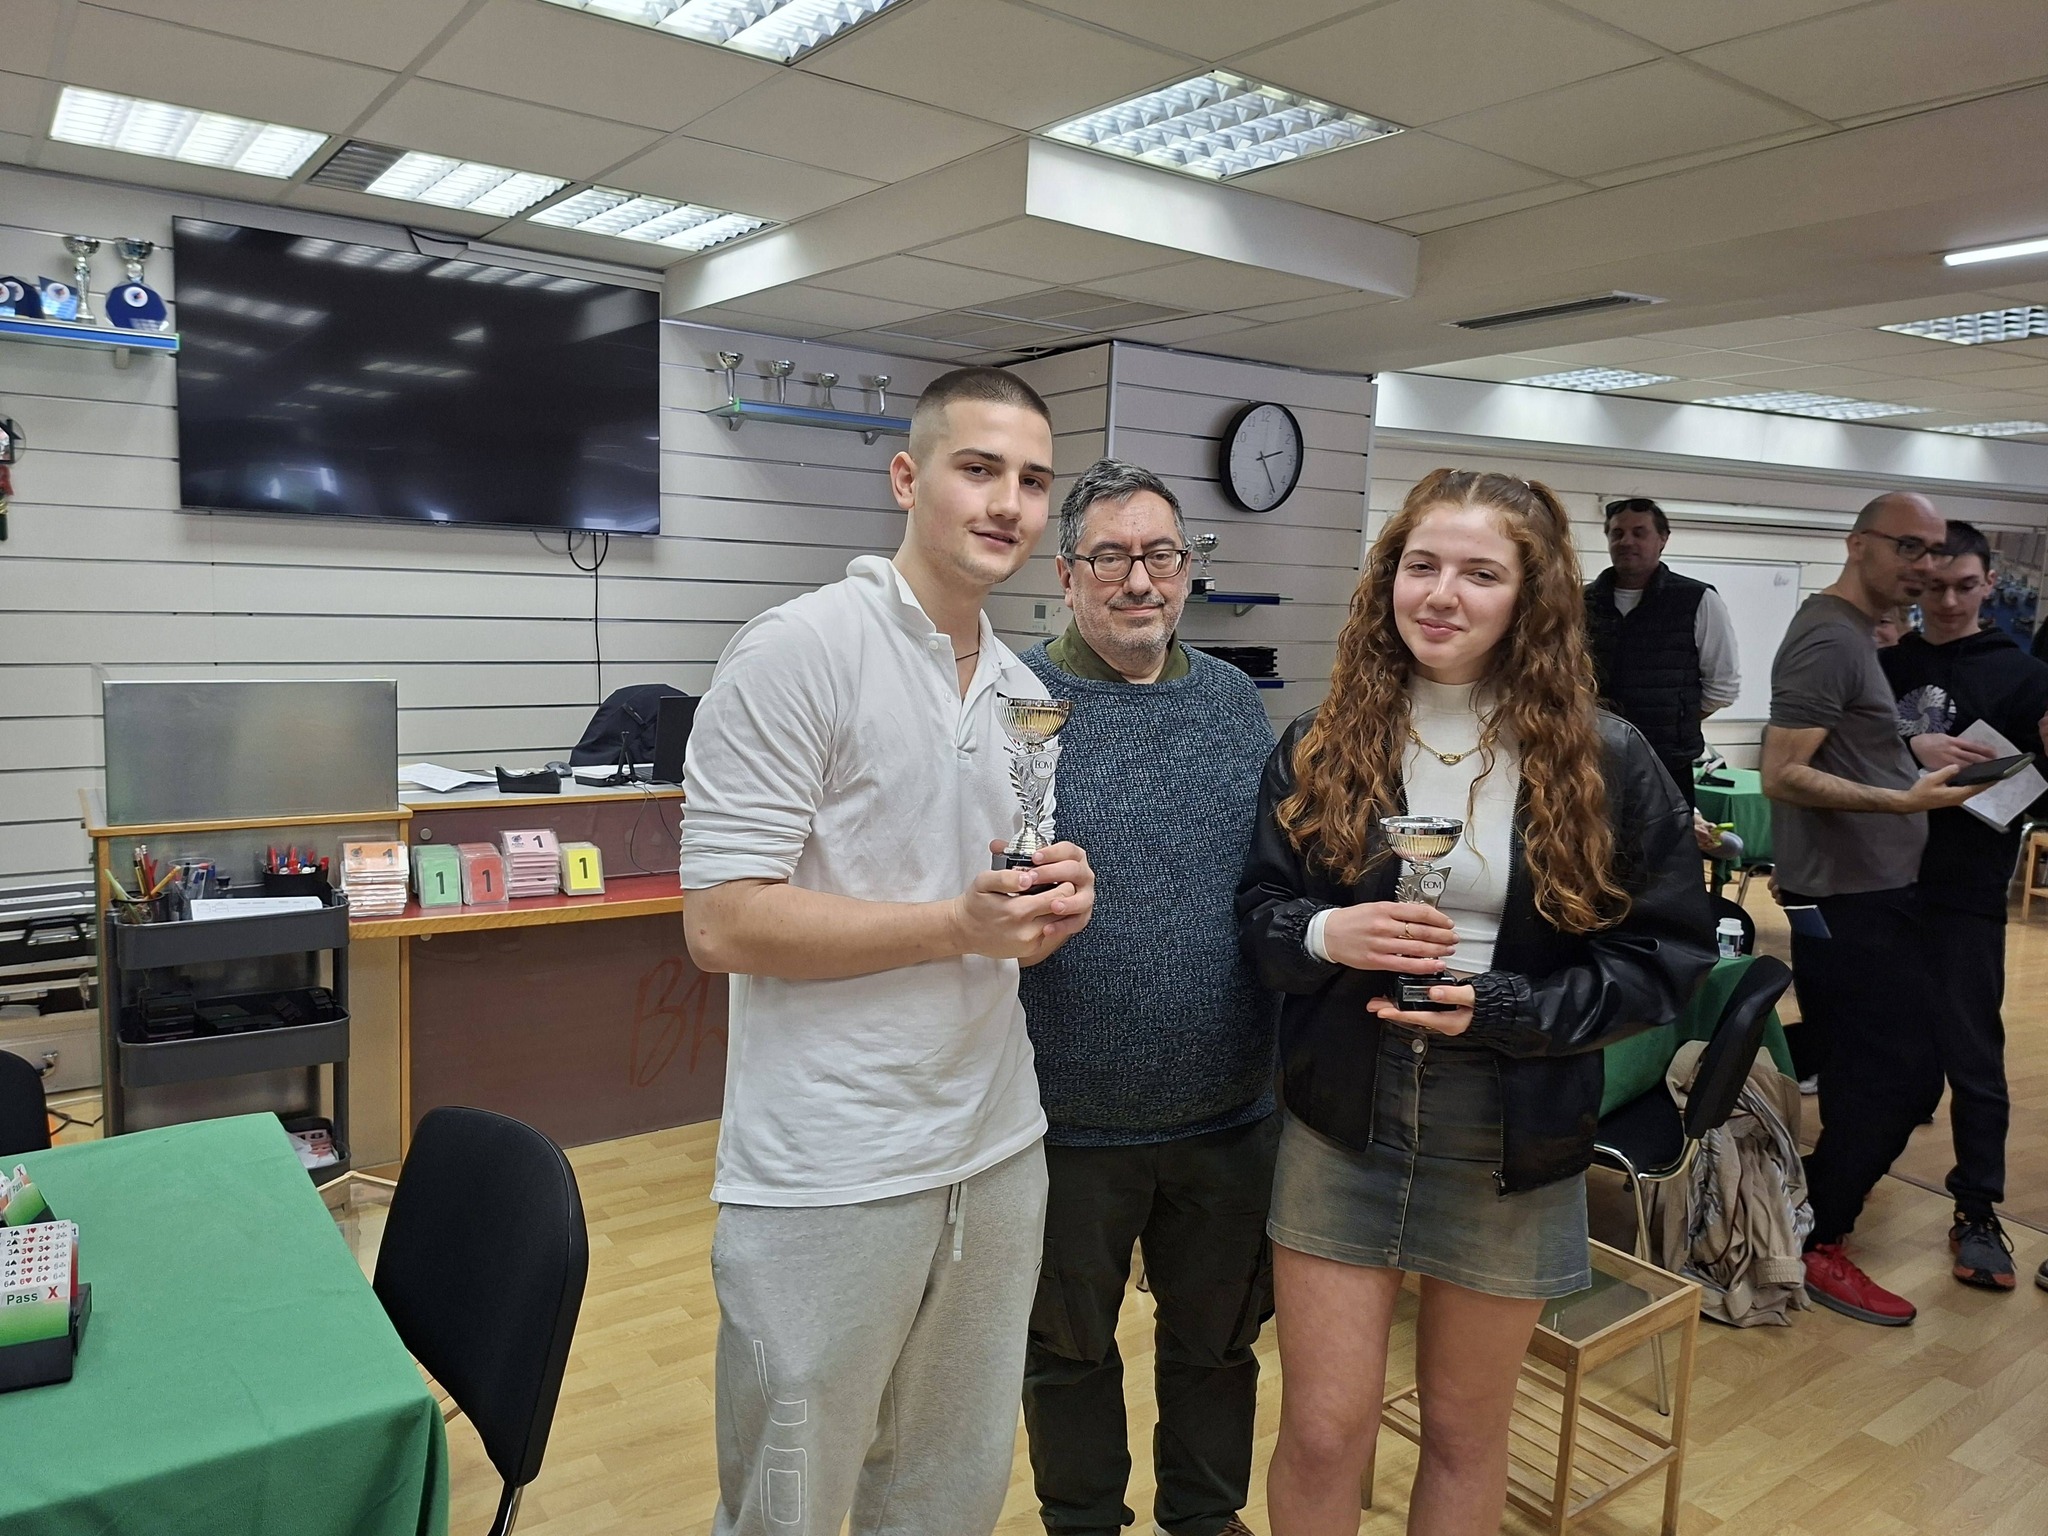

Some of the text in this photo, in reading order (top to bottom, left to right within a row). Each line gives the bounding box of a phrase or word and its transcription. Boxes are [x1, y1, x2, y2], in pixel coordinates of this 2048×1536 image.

[1247, 416, 1256, 428] 11
[1261, 410, 1271, 422] 12
[1235, 431, 1247, 443] 10
[533, 835, 543, 848] 1
[382, 848, 394, 865] 1
[578, 857, 588, 879] 1
[435, 871, 445, 895] 1
[482, 869, 492, 893] 1
[6, 1285, 58, 1305] Pass X
